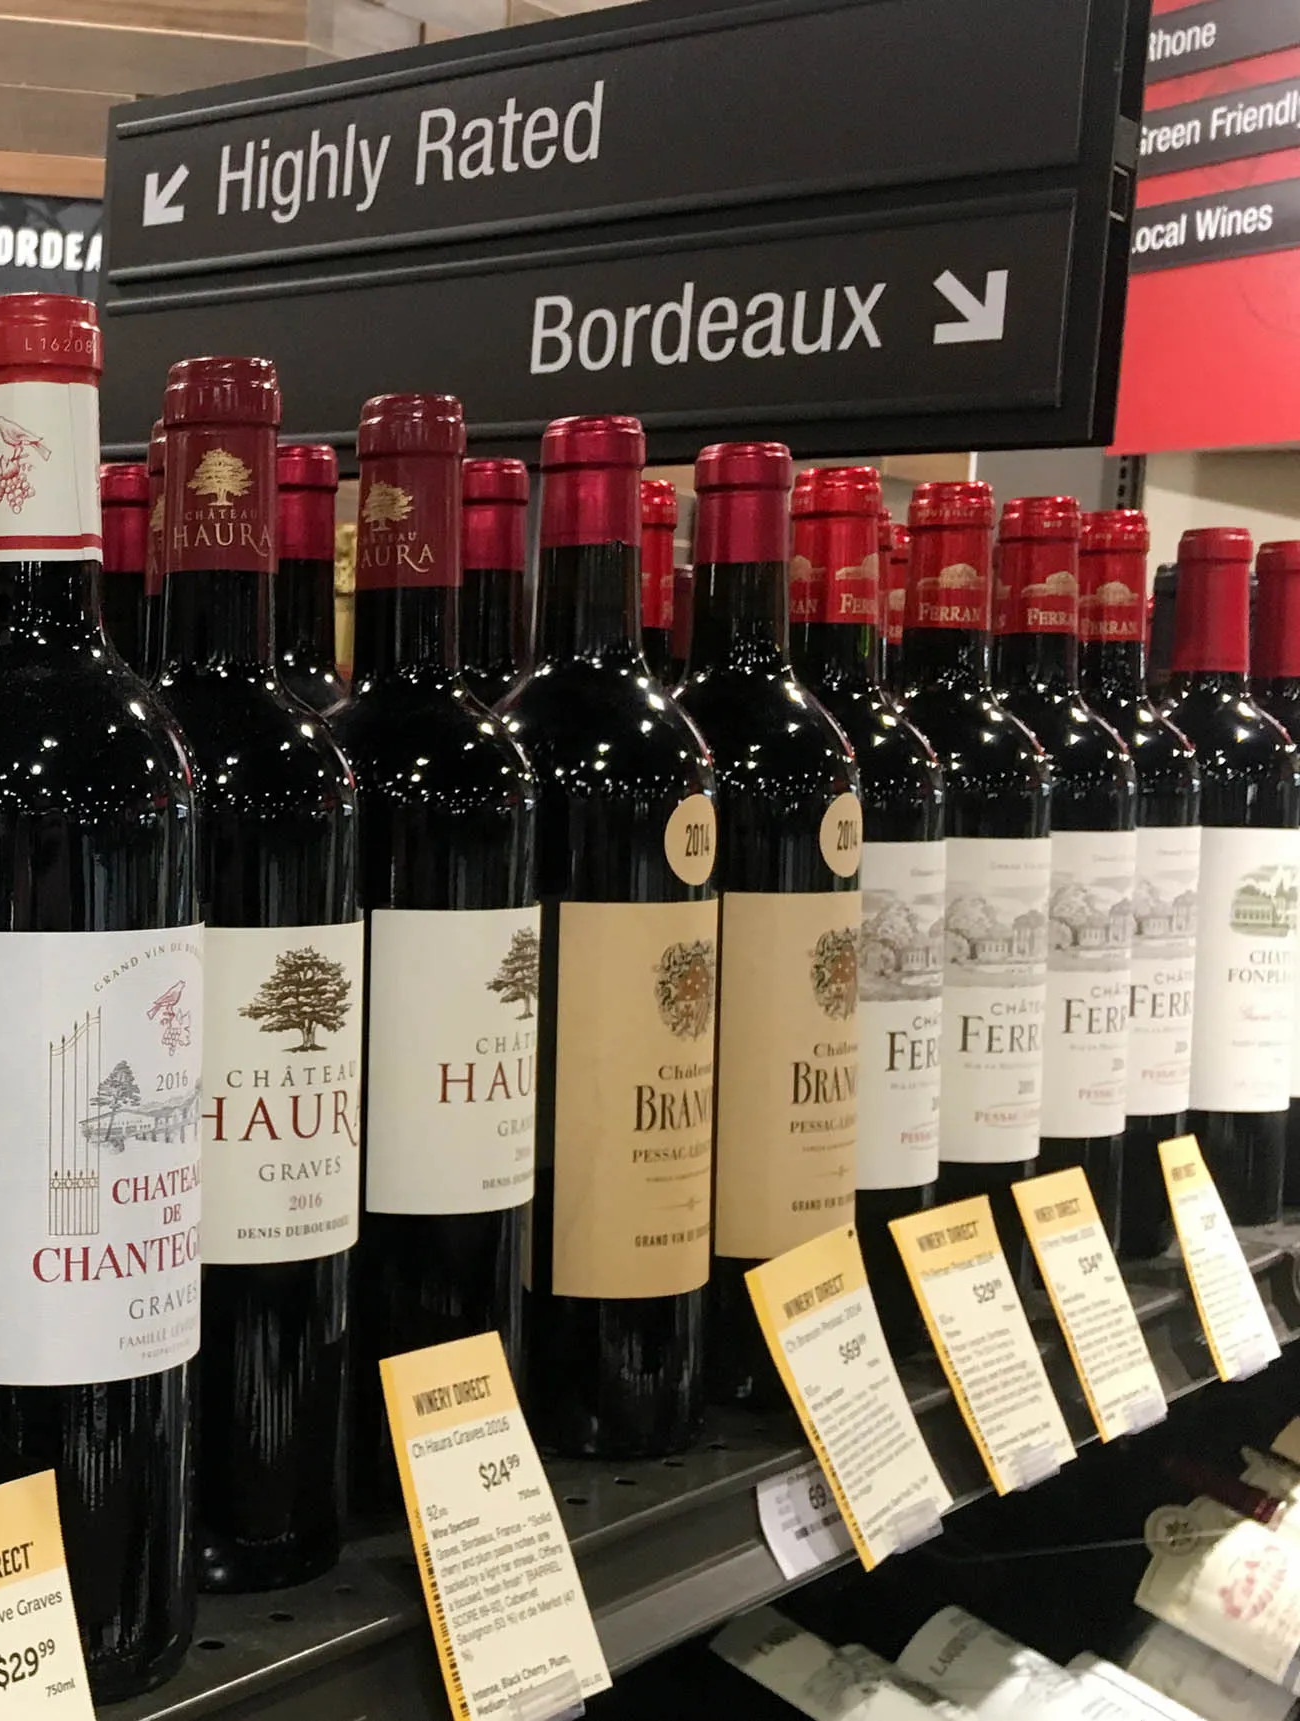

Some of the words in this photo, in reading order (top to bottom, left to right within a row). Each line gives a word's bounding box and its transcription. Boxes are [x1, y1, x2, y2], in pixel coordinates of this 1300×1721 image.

[218, 124, 391, 224] Highly
[415, 80, 605, 187] Rated
[1131, 213, 1188, 254] ocal
[1196, 203, 1273, 242] Wines
[529, 281, 888, 374] Bordeaux
[173, 522, 273, 557] HAURA
[360, 543, 435, 572] AURA
[918, 602, 983, 622] FERRAN
[685, 823, 711, 858] 2014
[837, 819, 859, 851] 2014
[94, 955, 140, 994] GRAND
[144, 944, 166, 960] VIN
[156, 1069, 189, 1092] 2016
[226, 1060, 356, 1089] CHÂTEAU
[437, 1055, 537, 1105] HAU
[202, 1087, 361, 1148] HAUR
[258, 1154, 343, 1183] GRAVES
[163, 1202, 182, 1225] DE
[288, 1192, 324, 1213] 2016
[237, 1225, 282, 1241] DENIS
[635, 1232, 669, 1248] GRAND
[32, 1224, 200, 1284] CHANTEG
[412, 1384, 454, 1417] WINERY
[453, 1374, 492, 1406] DIRECT
[412, 1441, 426, 1459] Ch
[454, 1426, 486, 1448] Graves
[16, 1589, 64, 1617] Graves
[44, 1676, 77, 1699] 750ml
